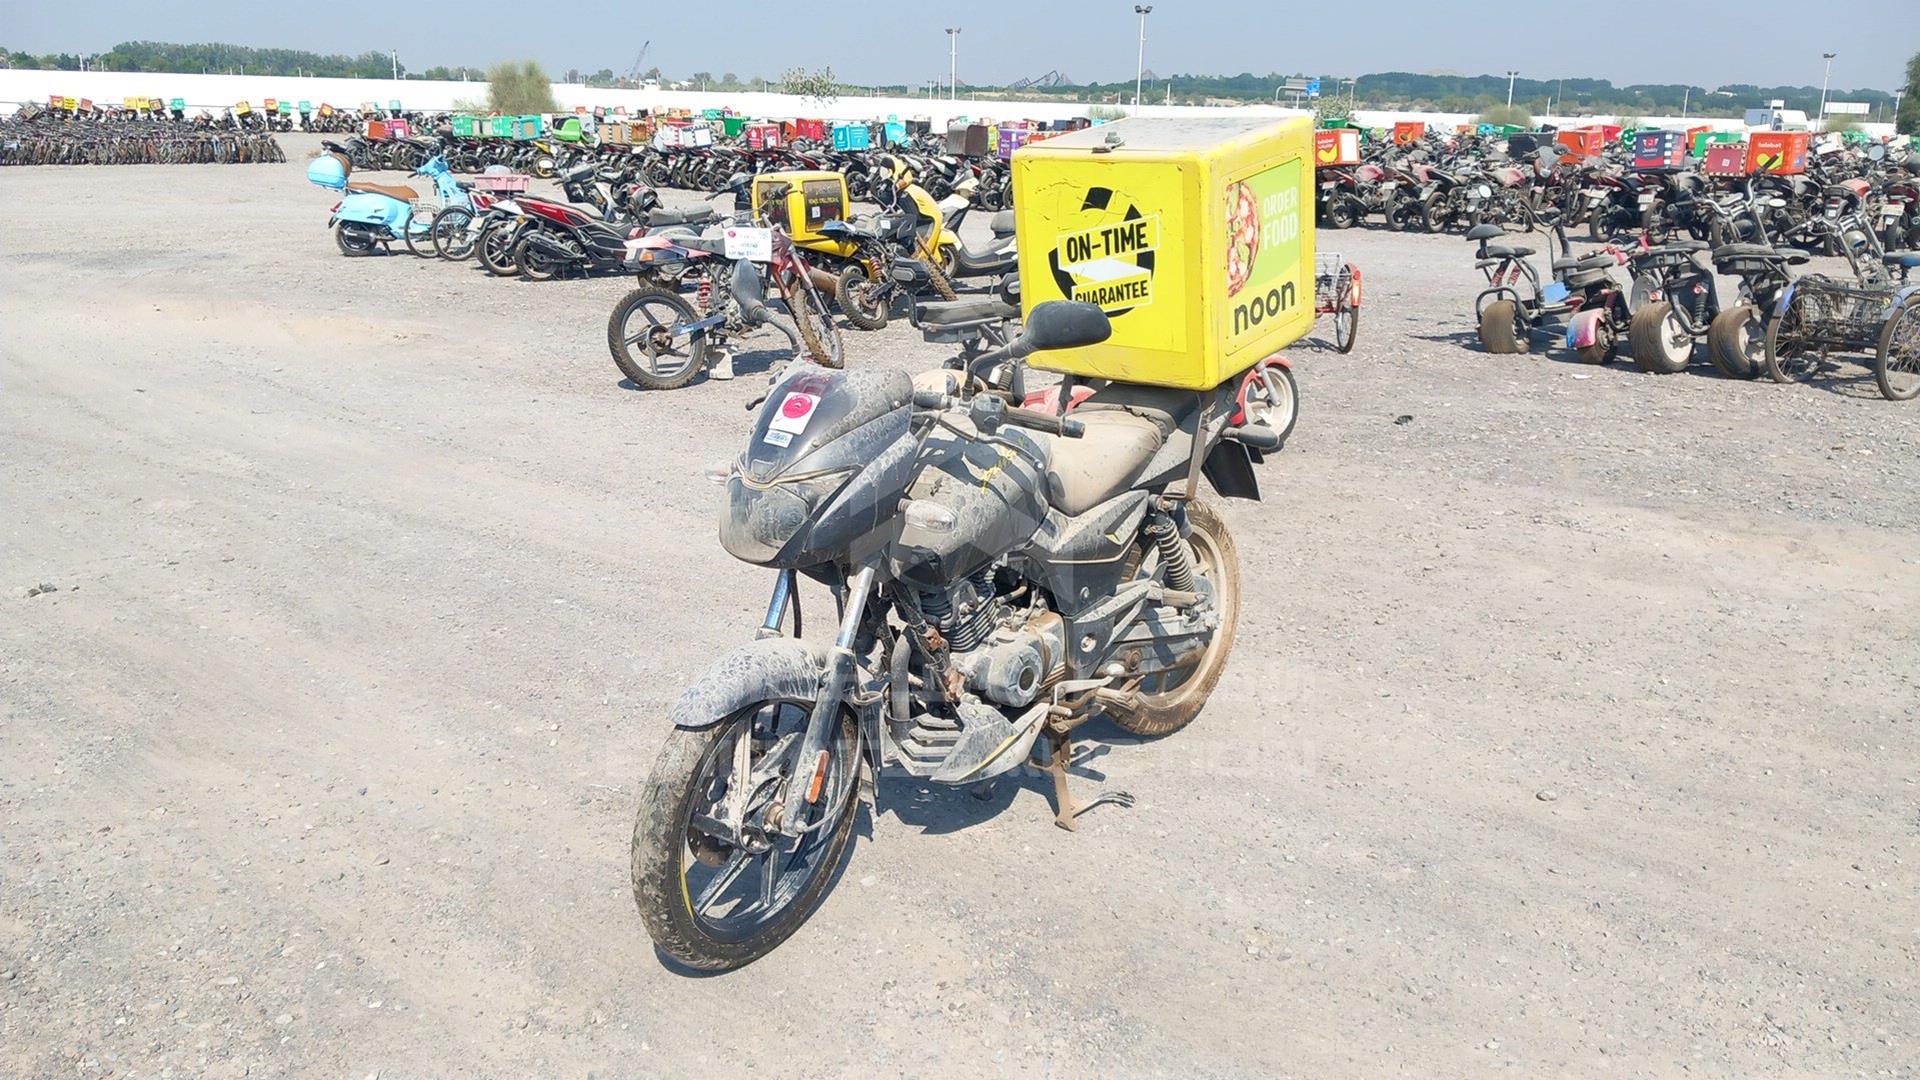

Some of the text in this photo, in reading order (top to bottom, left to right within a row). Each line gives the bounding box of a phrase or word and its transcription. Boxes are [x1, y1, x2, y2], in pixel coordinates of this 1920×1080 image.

[1263, 186, 1298, 219] ORDER
[1066, 222, 1148, 263] ON-TIME
[1263, 211, 1299, 251] FOOD
[1234, 281, 1296, 336] noon
